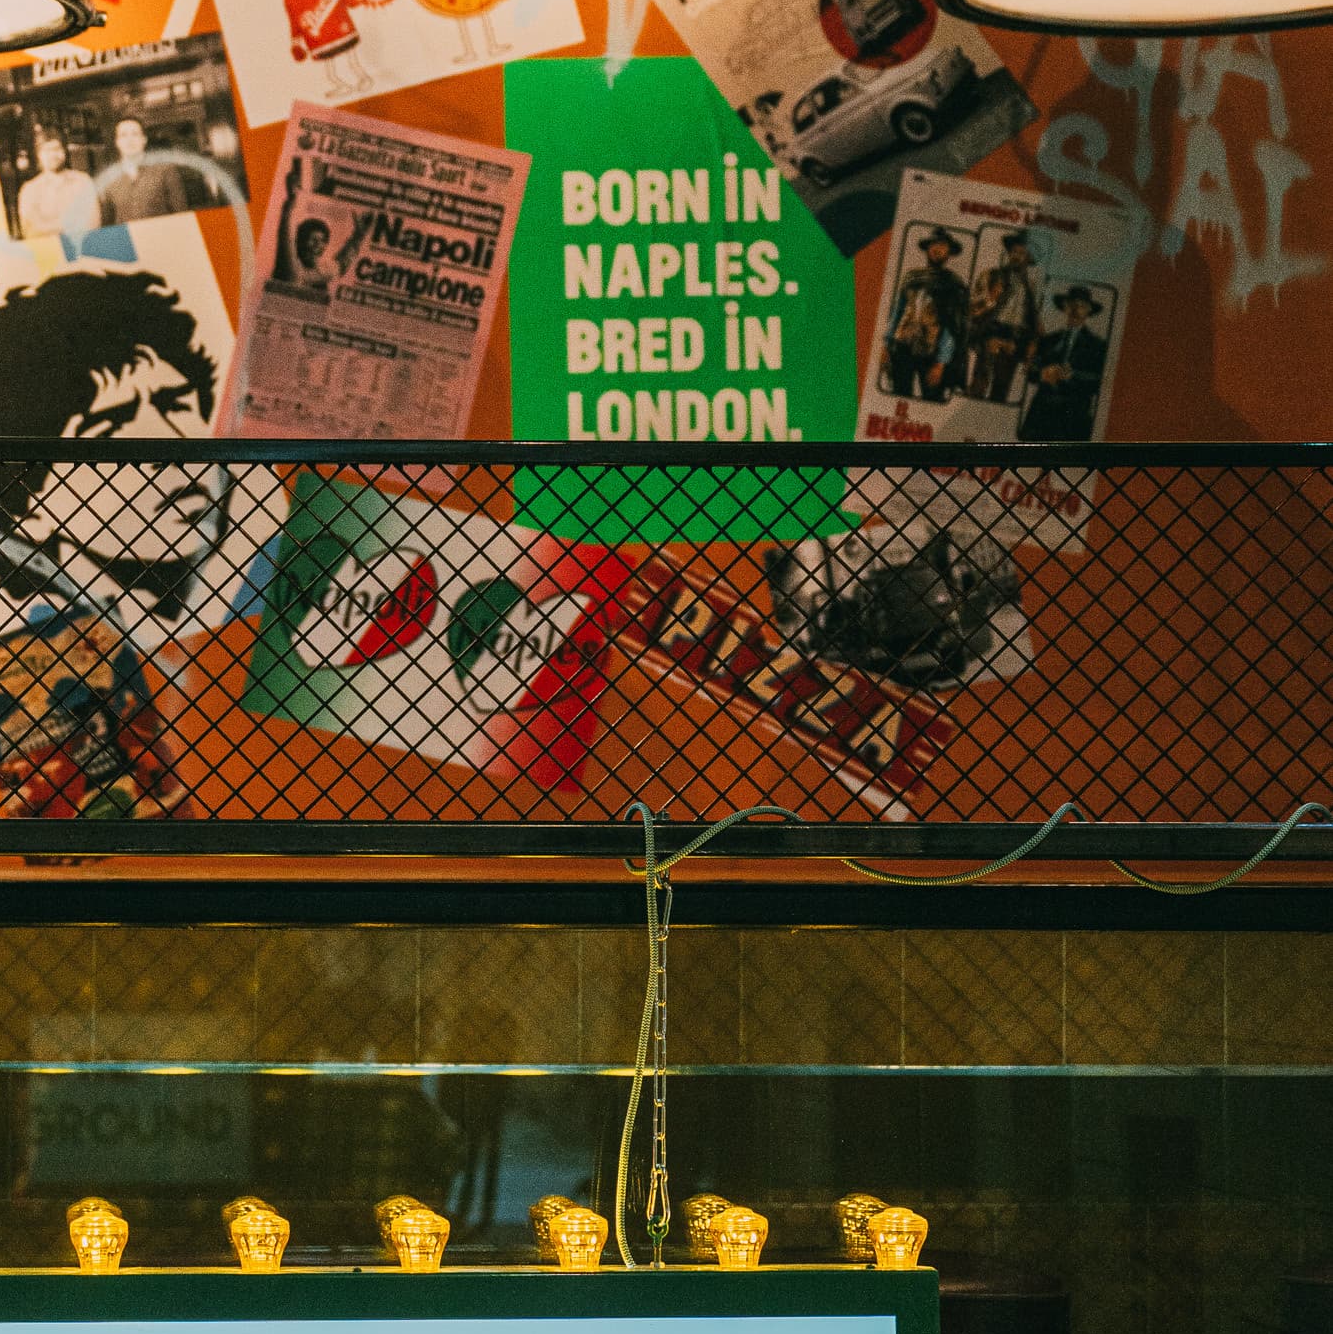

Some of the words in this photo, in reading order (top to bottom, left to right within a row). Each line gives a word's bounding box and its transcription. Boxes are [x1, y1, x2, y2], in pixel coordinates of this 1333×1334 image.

[562, 167, 712, 225] BORN
[372, 213, 497, 270] Napoli
[564, 241, 799, 299] NAPLES.
[354, 256, 485, 308] campione
[565, 316, 708, 374] BRED
[567, 388, 802, 443] LONDON.
[657, 586, 904, 765] PIZZA
